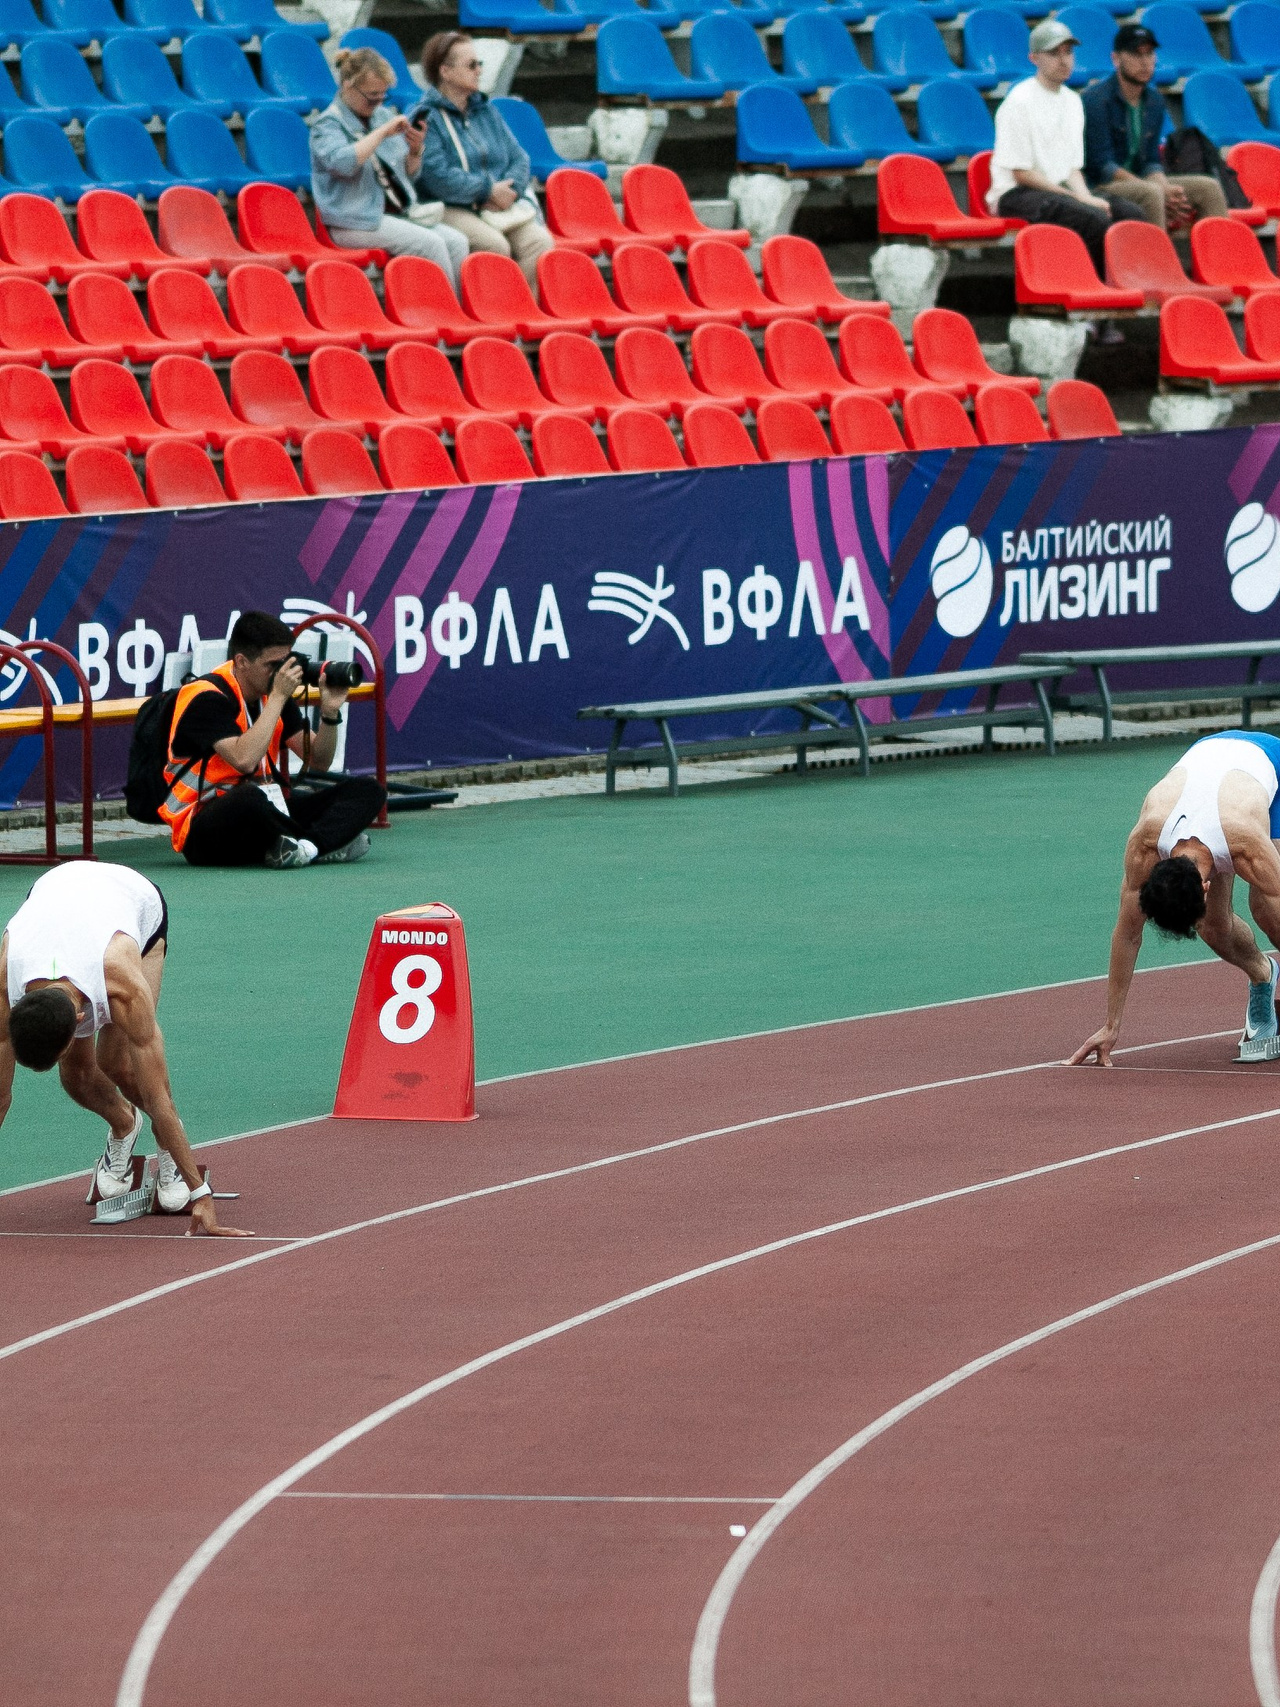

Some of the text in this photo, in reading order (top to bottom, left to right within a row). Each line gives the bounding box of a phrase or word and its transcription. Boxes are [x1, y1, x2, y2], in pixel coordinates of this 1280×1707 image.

[1002, 514, 1171, 563] БАЛТИЙСКИЙ
[394, 583, 570, 674] ВФЛА
[702, 555, 871, 646] ВФЛА
[1000, 558, 1171, 627] ЛИЗИНГ
[381, 929, 448, 946] MONDO
[378, 953, 443, 1044] 8
